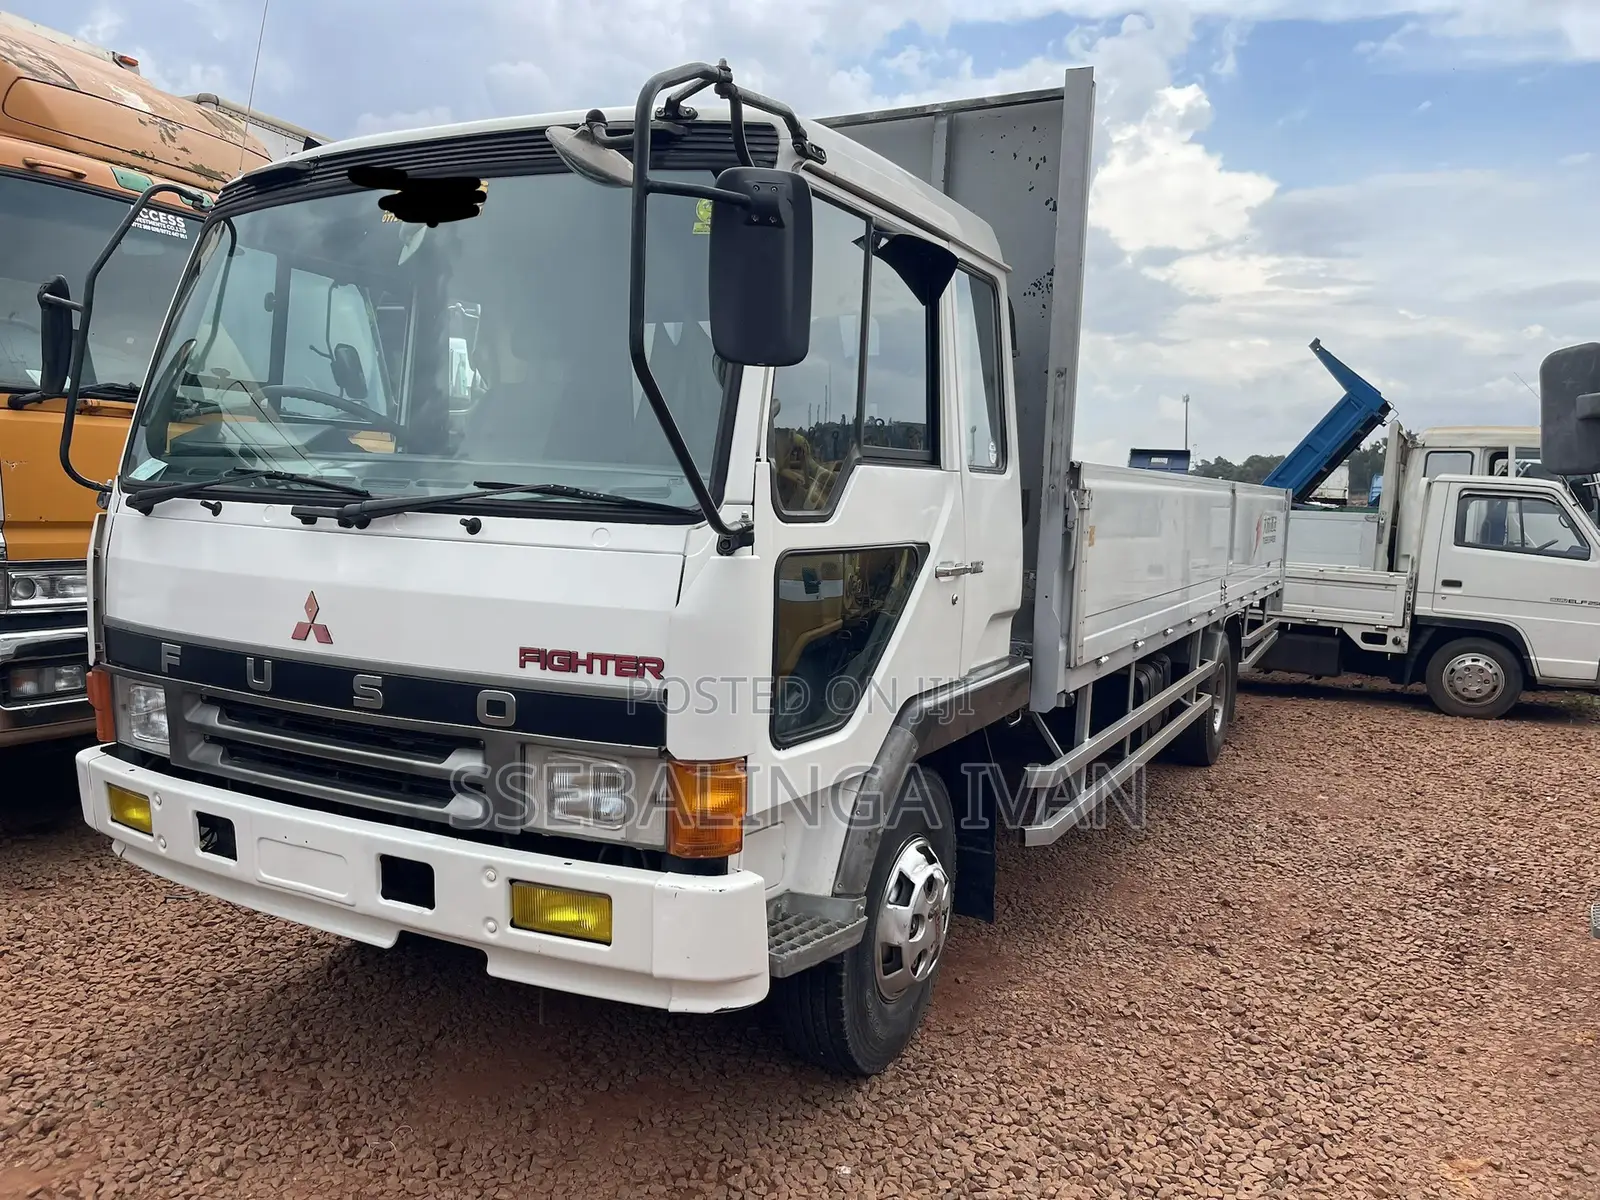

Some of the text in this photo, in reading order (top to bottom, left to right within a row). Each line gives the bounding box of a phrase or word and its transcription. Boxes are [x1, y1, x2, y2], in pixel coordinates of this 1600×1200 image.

[139, 207, 186, 228] CCESS
[519, 646, 665, 680] FIGHTER
[161, 642, 517, 728] FUSO
